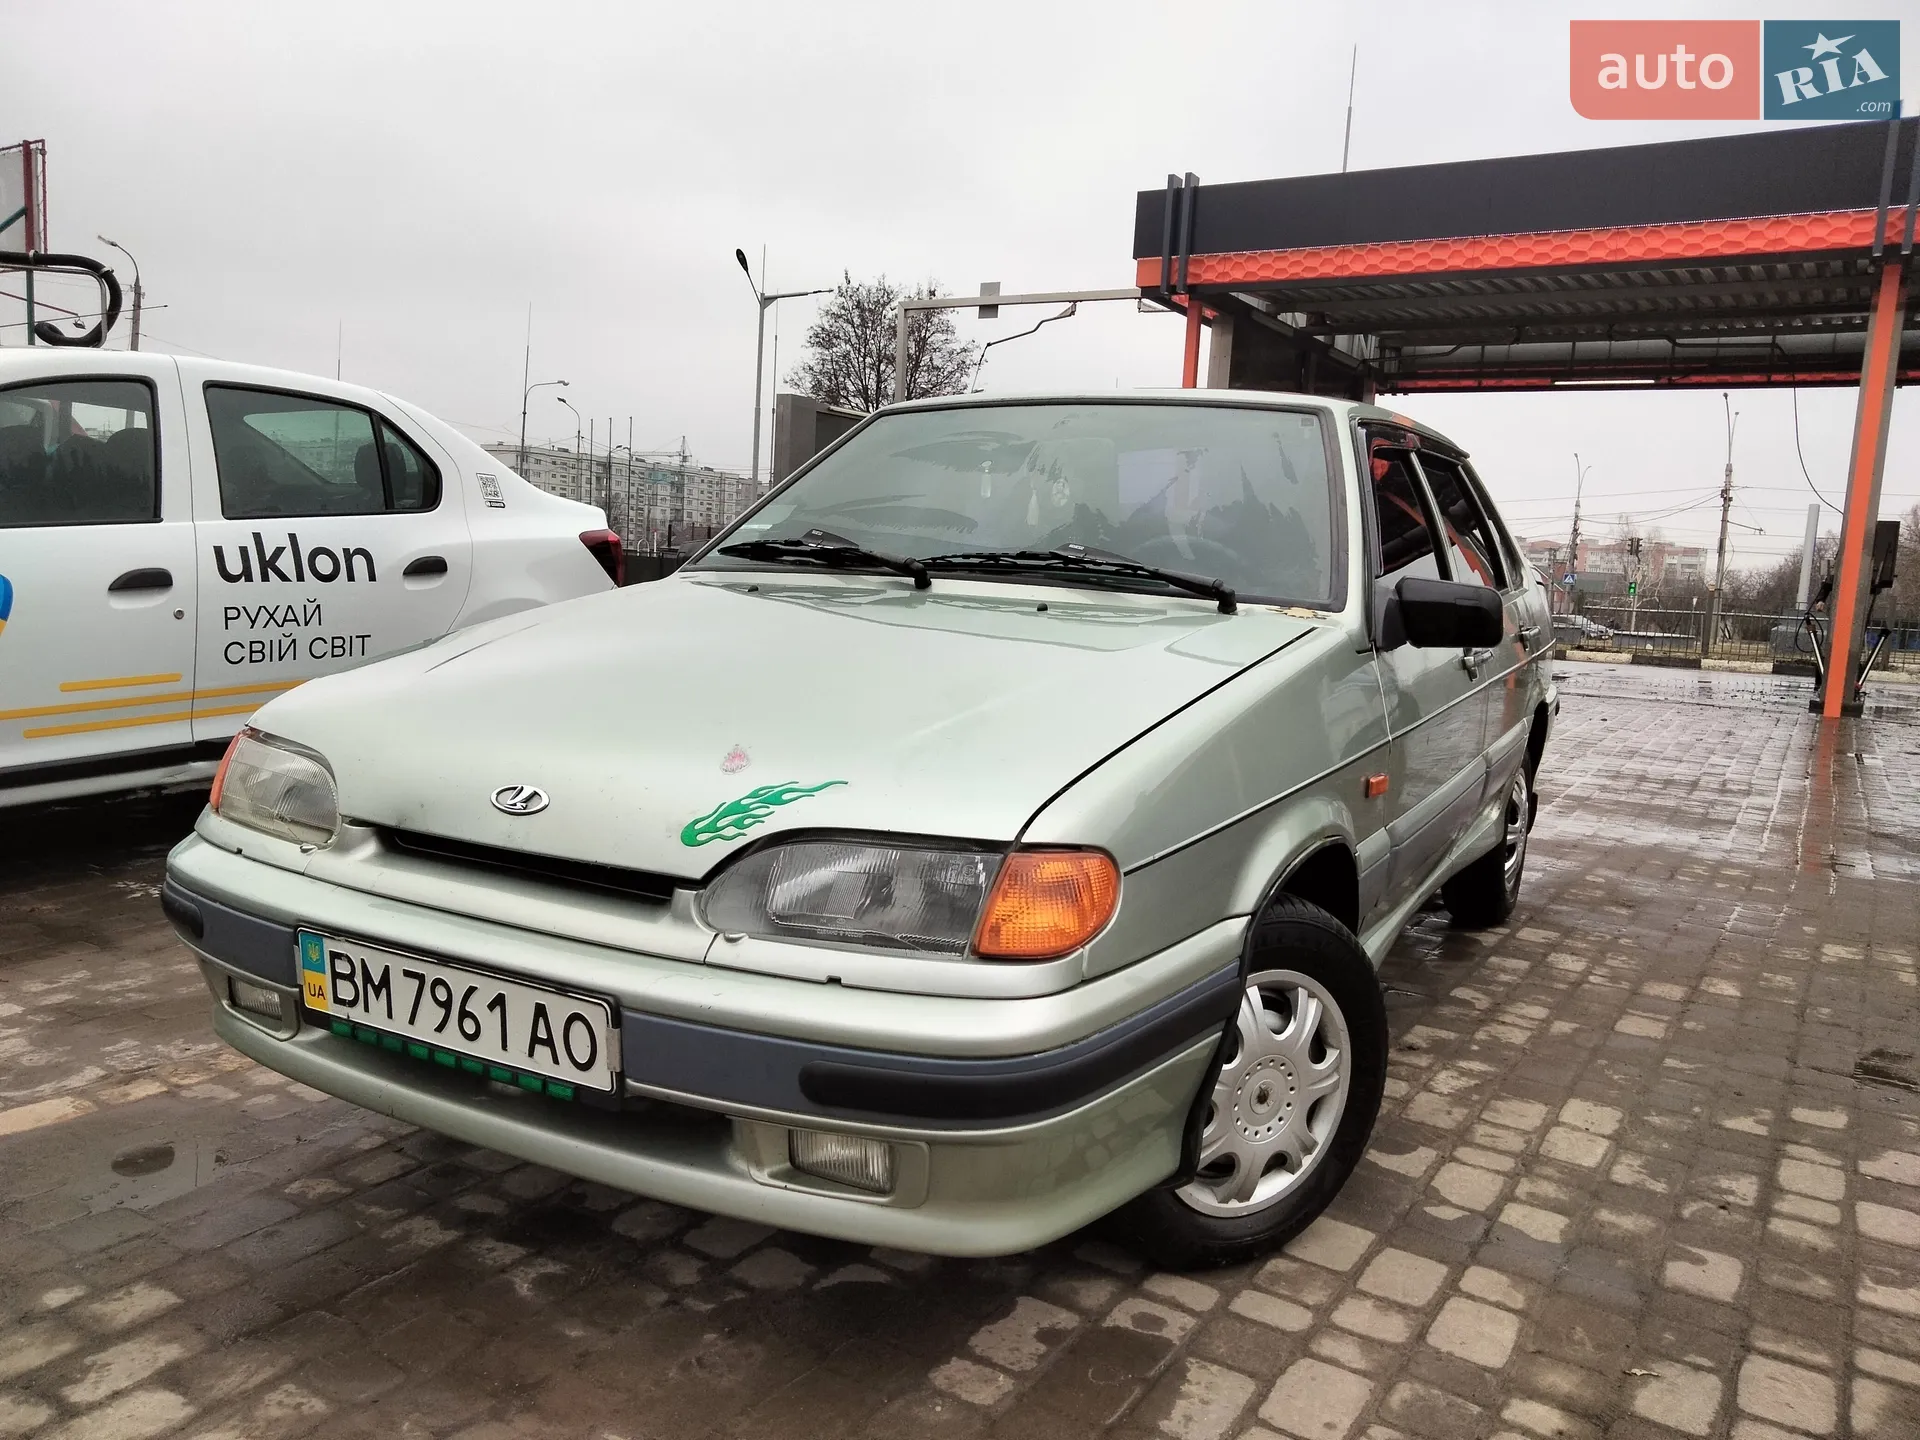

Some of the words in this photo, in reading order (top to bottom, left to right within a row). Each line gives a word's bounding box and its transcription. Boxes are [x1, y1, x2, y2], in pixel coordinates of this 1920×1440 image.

[212, 532, 377, 583] uklon
[223, 598, 322, 630] РУХАЙ
[223, 632, 297, 665] СВІЙ
[308, 634, 372, 660] СВІТ
[308, 982, 326, 1001] UA
